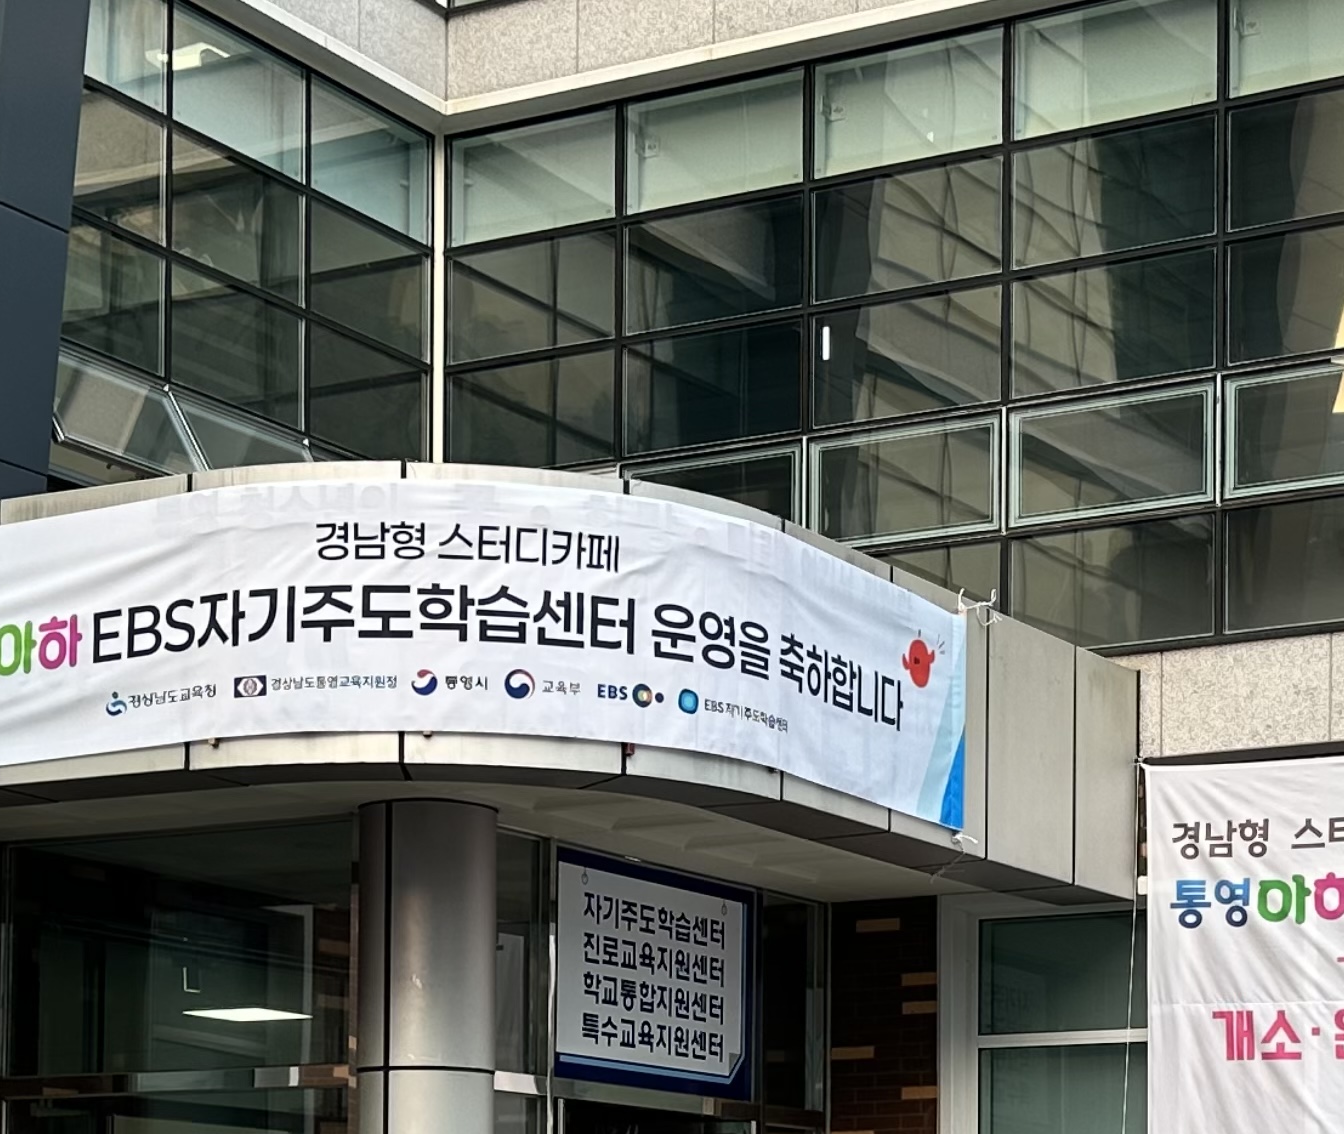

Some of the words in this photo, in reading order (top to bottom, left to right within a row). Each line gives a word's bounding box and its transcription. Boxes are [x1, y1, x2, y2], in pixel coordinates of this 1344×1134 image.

[316, 521, 426, 560] 경남형
[437, 523, 620, 573] 스터디카페
[445, 675, 489, 691] 통영시
[542, 679, 581, 695] 교육부
[597, 683, 628, 700] EBS
[651, 602, 772, 681] 운영을
[780, 631, 904, 732] 축하합니다
[127, 684, 217, 709] 경상남도교육청
[1171, 818, 1270, 860] 경남형
[584, 891, 725, 950] 자기주도학습센터
[584, 932, 725, 988] 진로교육지원센터
[583, 971, 724, 1025] 학교통합지원센터
[581, 1012, 724, 1063] 특수교육지원센터
